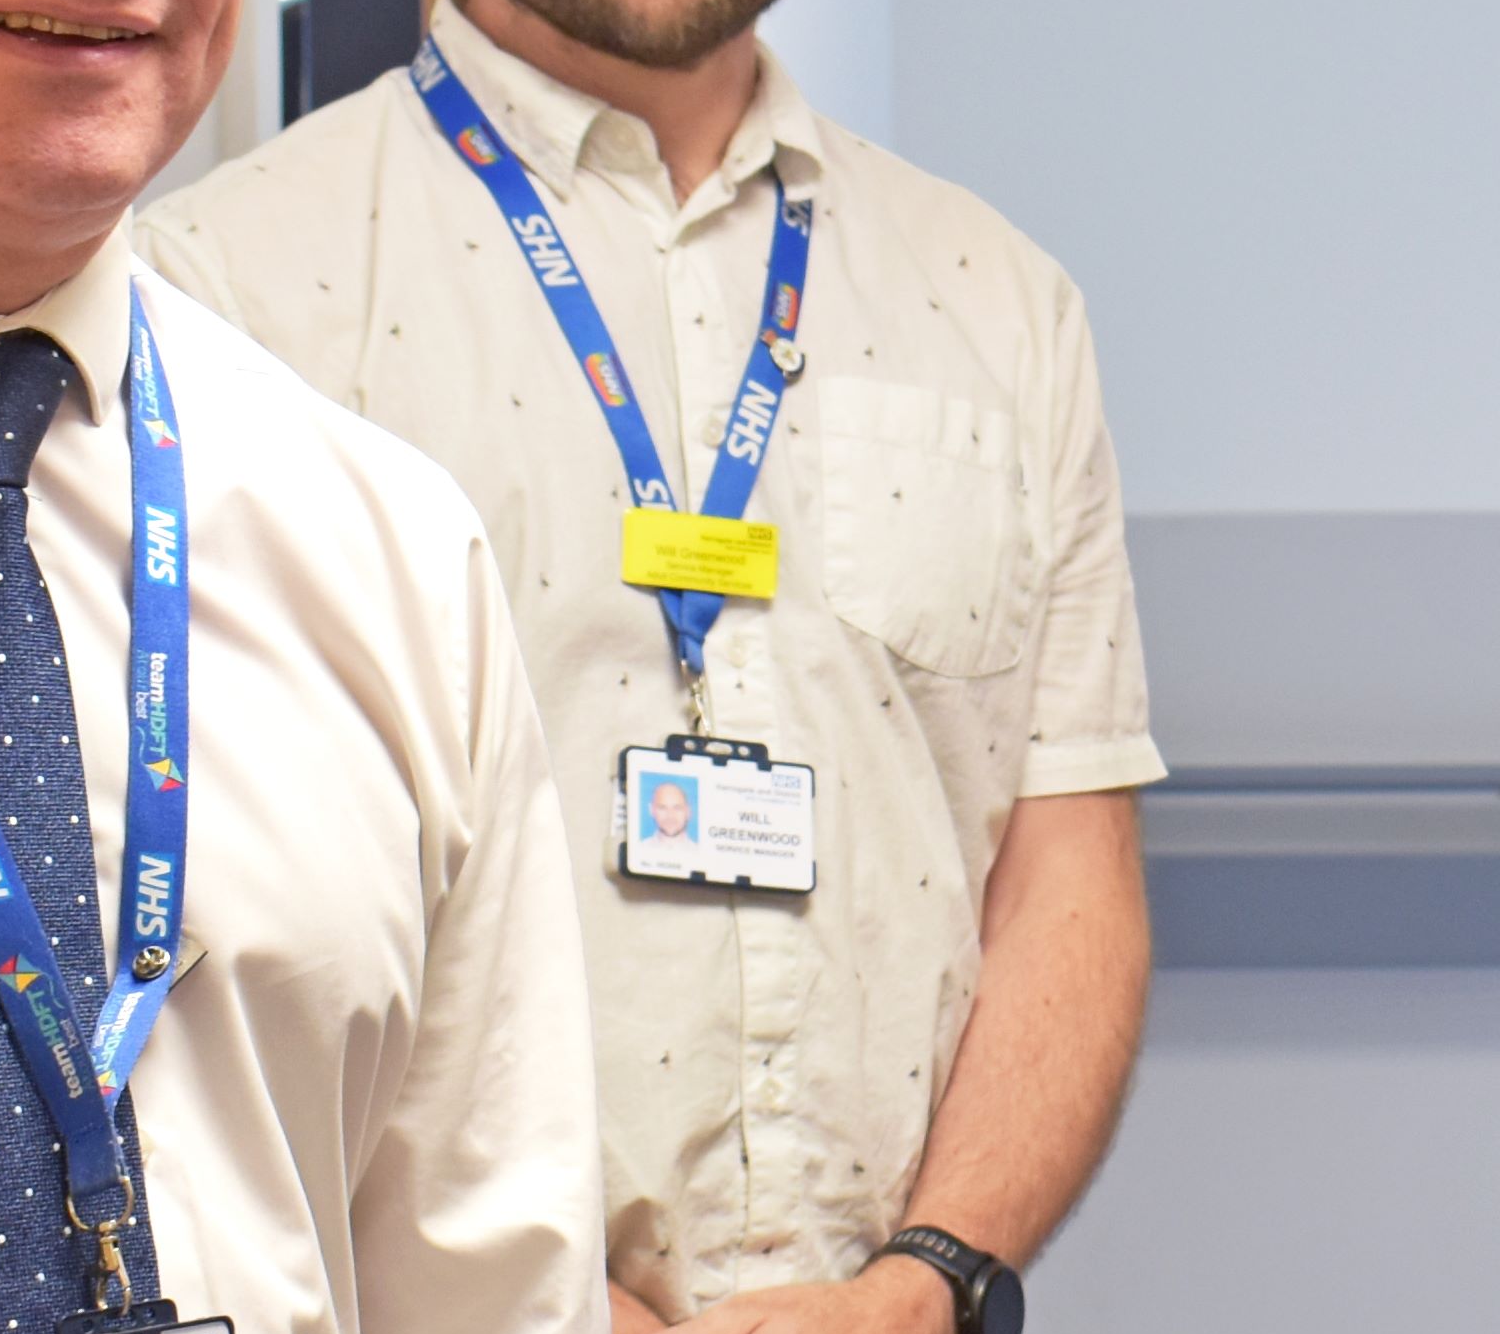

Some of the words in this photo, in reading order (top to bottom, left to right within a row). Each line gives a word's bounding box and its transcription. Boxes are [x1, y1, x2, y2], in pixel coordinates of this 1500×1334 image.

[512, 214, 579, 286] NHS
[726, 380, 776, 466] NHS
[146, 505, 176, 585] NHS
[149, 652, 168, 758] teamHDFT
[708, 826, 801, 846] GREENWOOD
[738, 811, 771, 825] WILL
[136, 854, 171, 938] NHS
[26, 990, 83, 1100] teamHDFT
